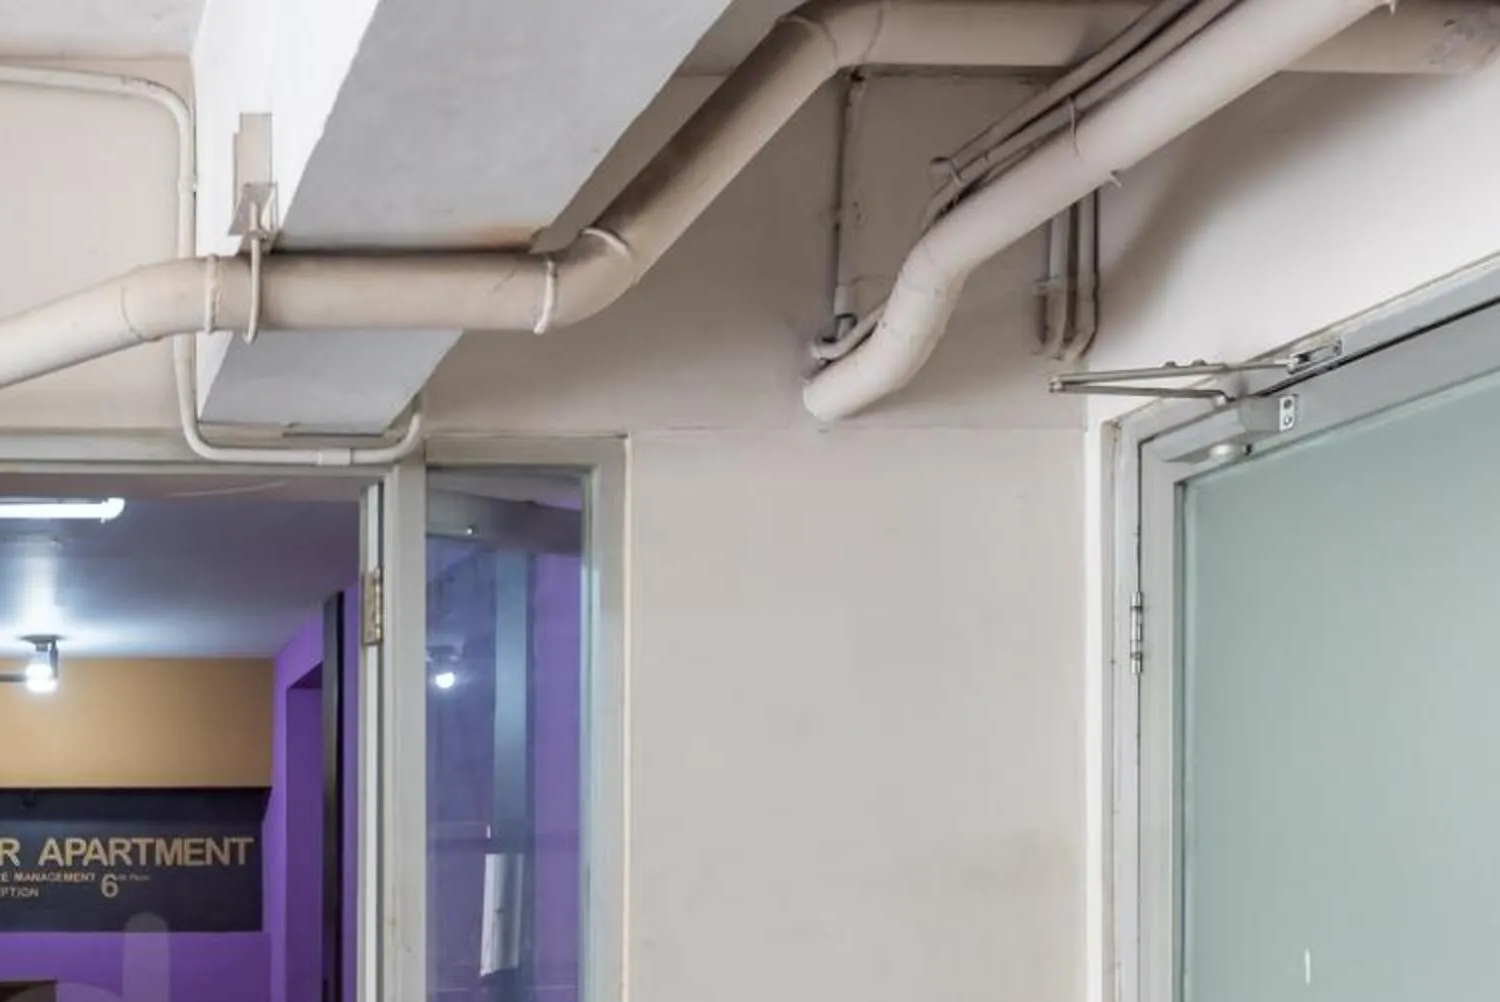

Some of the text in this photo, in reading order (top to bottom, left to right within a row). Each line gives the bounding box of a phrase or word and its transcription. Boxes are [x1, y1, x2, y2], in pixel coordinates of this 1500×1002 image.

[38, 836, 255, 867] APARTMENT
[13, 872, 96, 883] MANAGEMENT
[101, 873, 119, 898] 6
